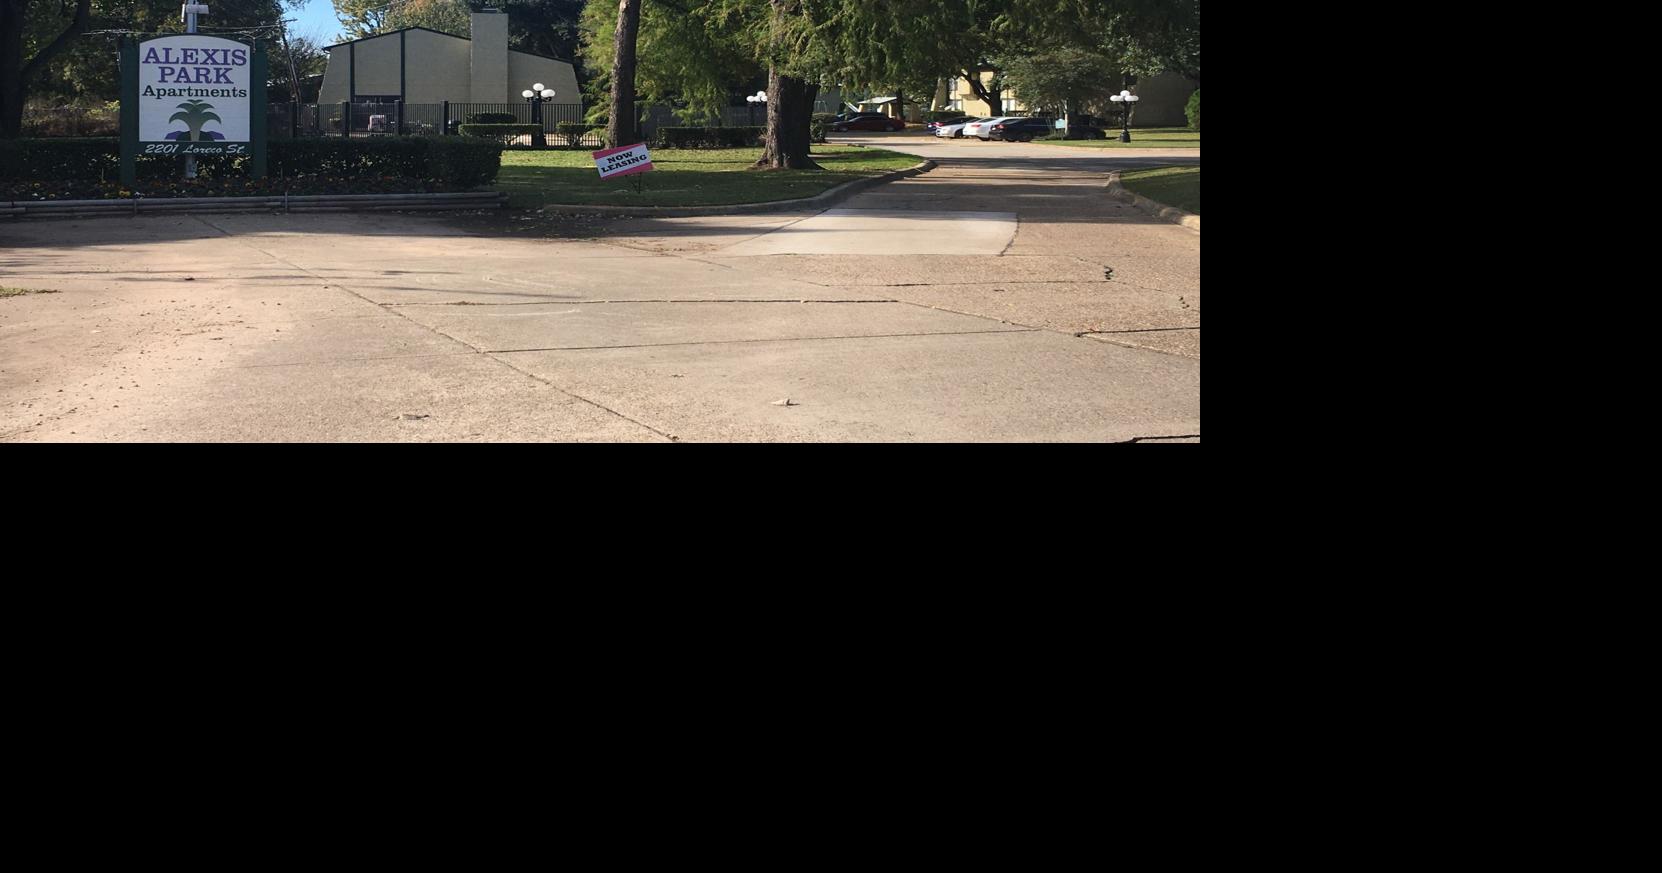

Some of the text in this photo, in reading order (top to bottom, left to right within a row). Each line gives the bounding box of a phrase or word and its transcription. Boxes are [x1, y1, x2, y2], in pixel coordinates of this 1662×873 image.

[142, 47, 247, 66] ALEXIS
[158, 66, 234, 84] PARK
[142, 85, 247, 99] Apartments
[145, 144, 179, 154] 2201
[606, 151, 633, 163] NOW
[601, 154, 647, 172] LEASING
